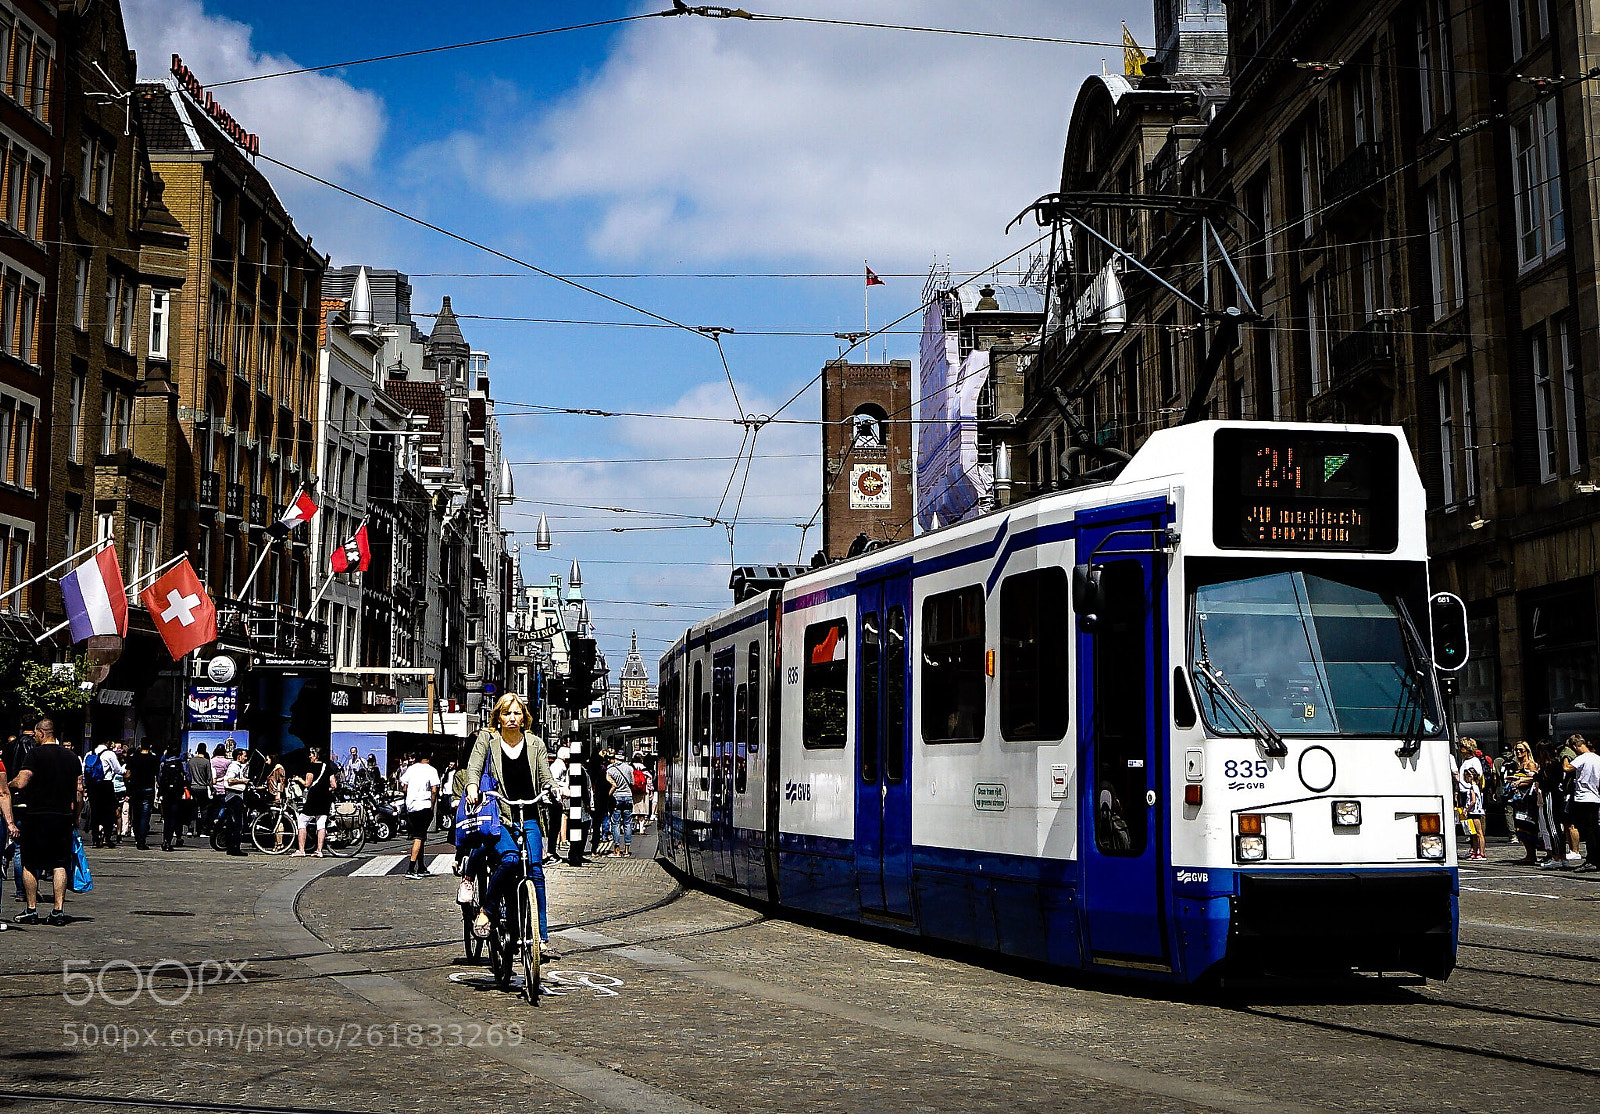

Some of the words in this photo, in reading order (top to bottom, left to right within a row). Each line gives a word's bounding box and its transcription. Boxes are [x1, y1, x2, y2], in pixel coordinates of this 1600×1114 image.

[1257, 447, 1301, 489] 24
[517, 626, 556, 640] CASINO
[787, 666, 799, 685] 835
[1224, 759, 1268, 779] 835
[797, 783, 811, 802] GVB
[1246, 782, 1265, 790] GVB
[1191, 872, 1209, 883] GVB
